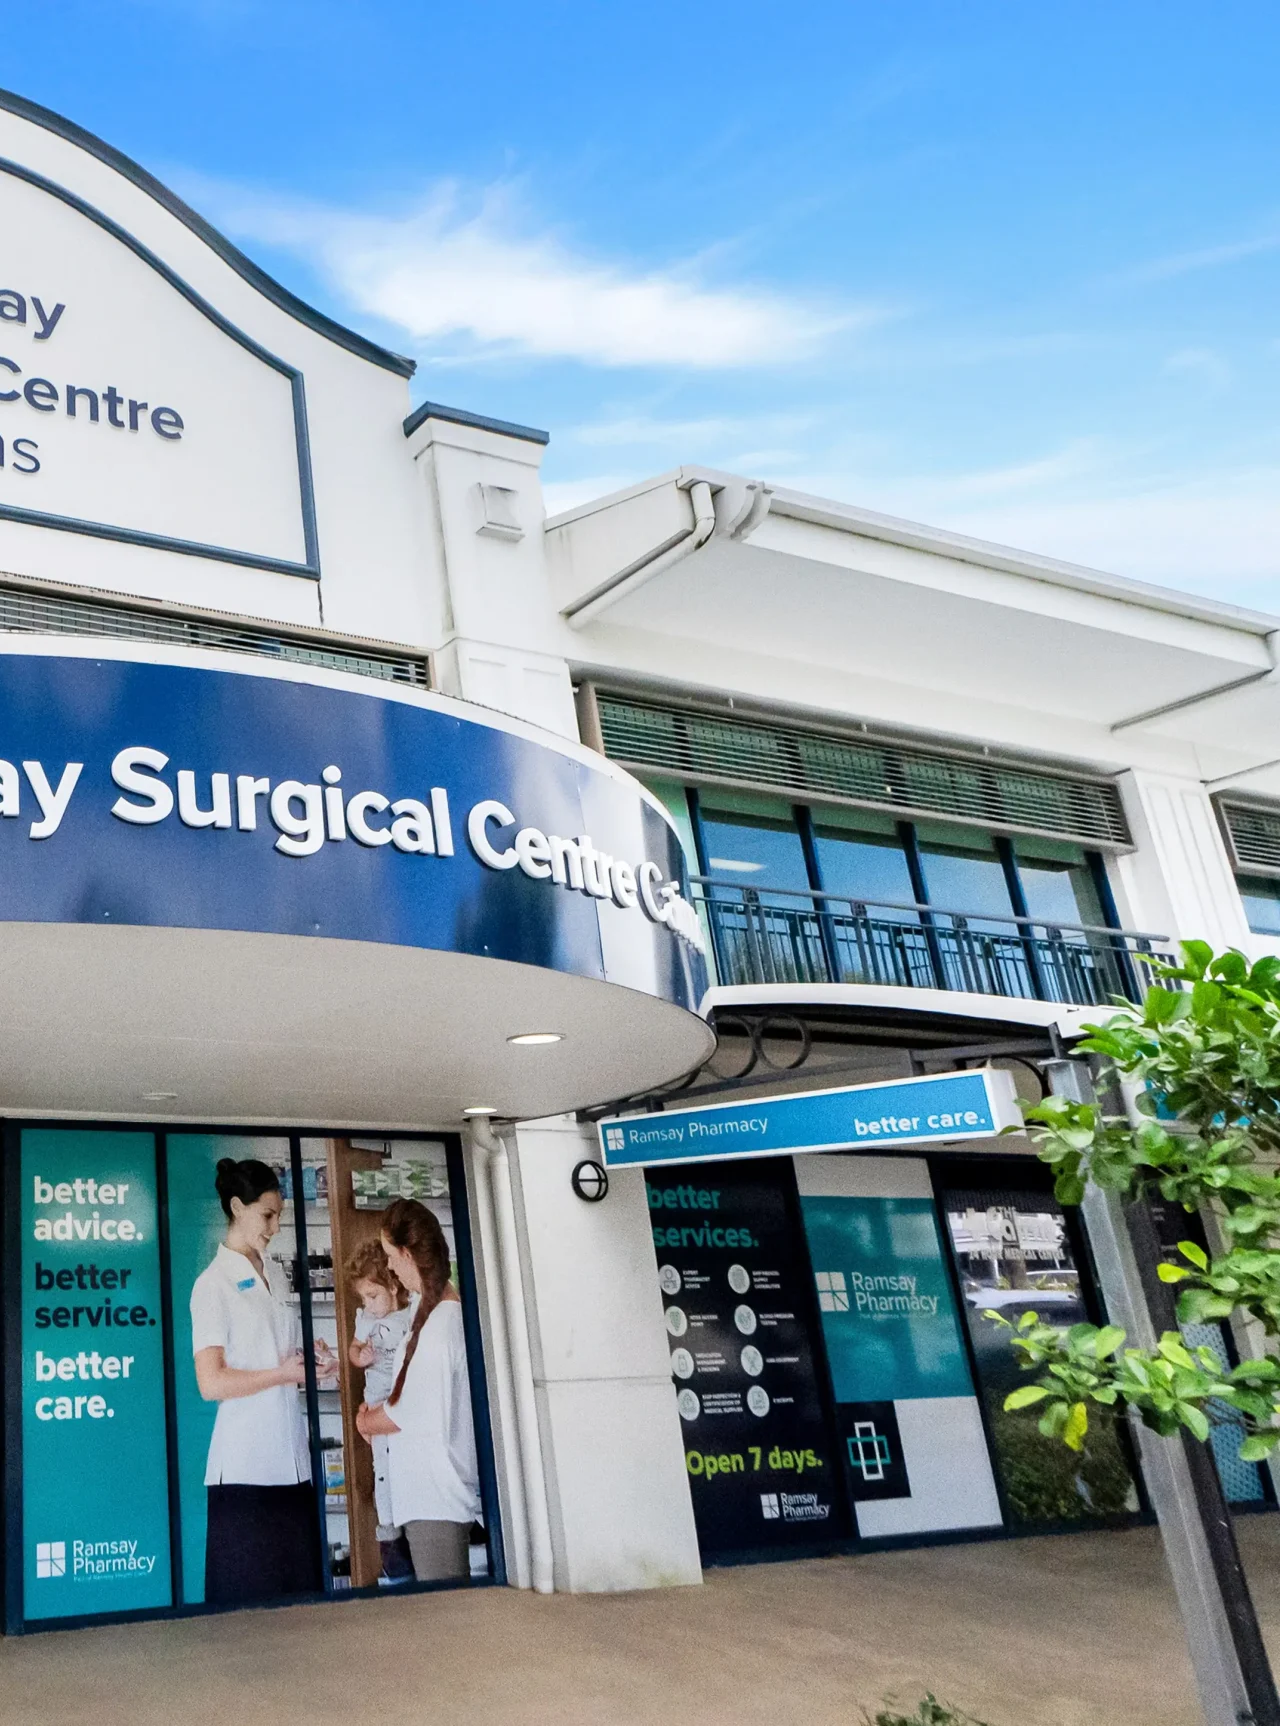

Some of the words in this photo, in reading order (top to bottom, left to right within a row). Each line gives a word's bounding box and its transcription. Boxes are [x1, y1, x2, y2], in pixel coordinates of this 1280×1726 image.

[110, 746, 455, 857] Surgical
[468, 799, 638, 909] Centre
[629, 1127, 685, 1144] Ramsay
[688, 1116, 769, 1138] Pharmacy
[854, 1117, 920, 1136] better
[927, 1110, 986, 1130] care.
[33, 1175, 129, 1205] better
[646, 1182, 721, 1210] better
[33, 1211, 144, 1242] advice.
[653, 1220, 760, 1248] services.
[35, 1261, 132, 1291] better
[851, 1271, 917, 1295] Ramsay
[34, 1297, 157, 1329] service.
[855, 1291, 939, 1314] Pharmacy
[35, 1350, 135, 1382] better
[35, 1394, 115, 1421] care.
[685, 1450, 745, 1480] Open
[747, 1446, 762, 1471] 7
[768, 1445, 823, 1474] days.
[780, 1492, 818, 1507] Ramsay
[782, 1504, 831, 1518] Pharmacy
[73, 1540, 138, 1557] Ramsay
[73, 1555, 156, 1575] Pharmacy
